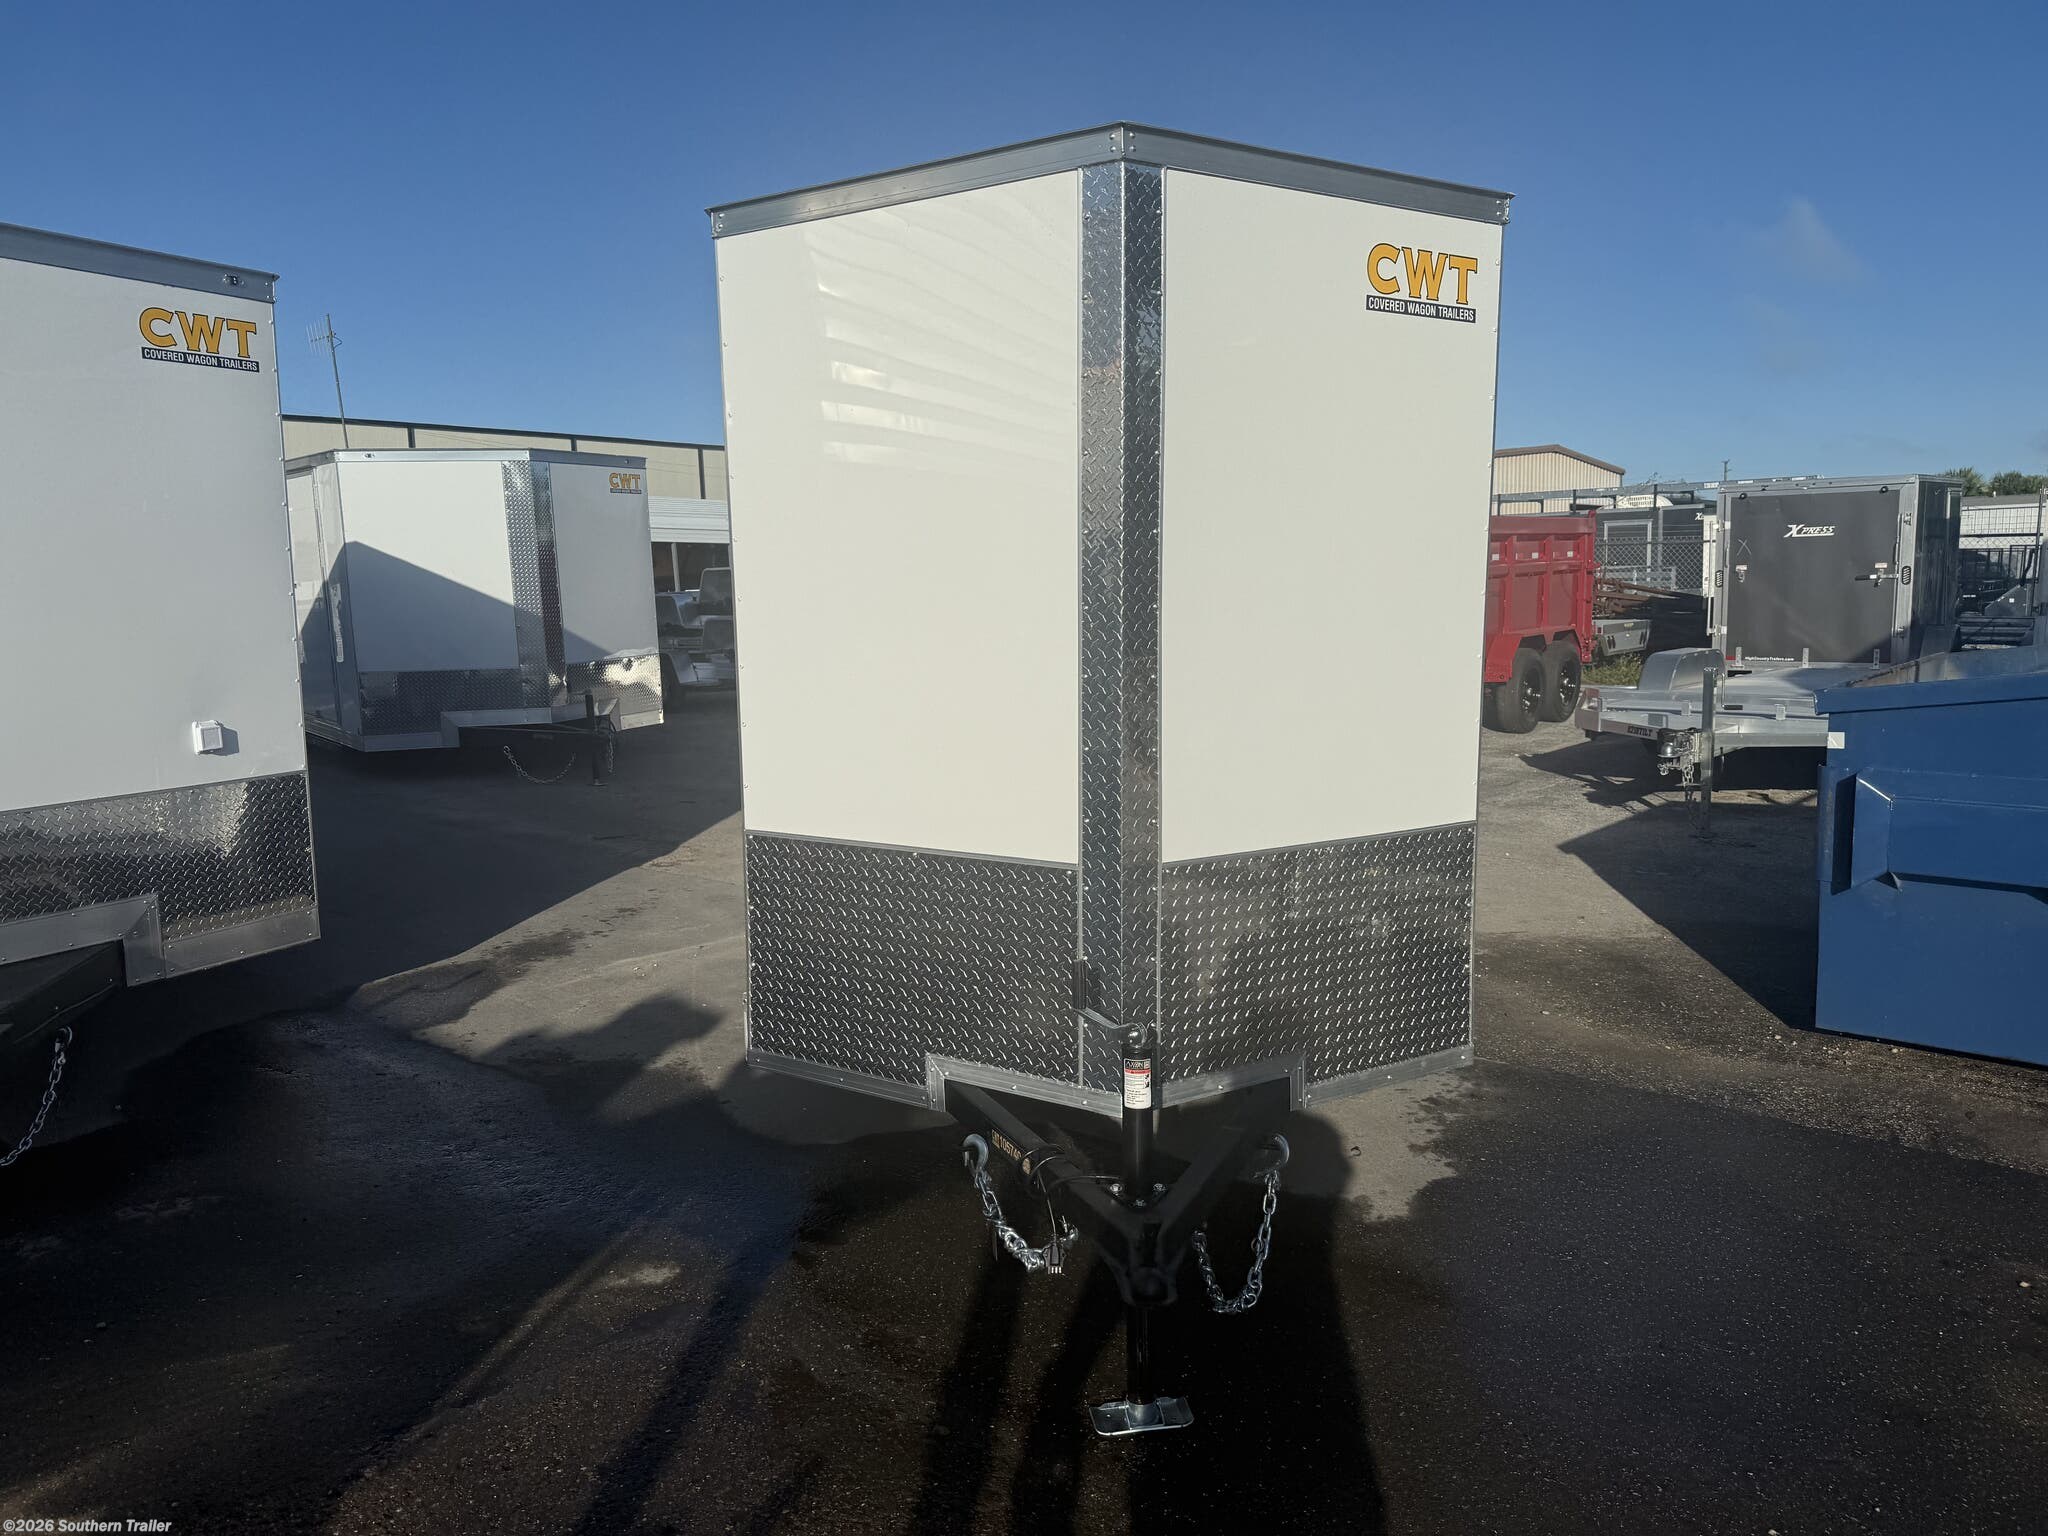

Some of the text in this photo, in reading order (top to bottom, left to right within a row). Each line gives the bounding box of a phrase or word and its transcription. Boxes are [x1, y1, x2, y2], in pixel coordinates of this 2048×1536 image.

[1367, 243, 1478, 305] CWT
[1368, 296, 1474, 321] COVERED WAGON TRAILERS
[139, 307, 258, 358] CWT
[144, 348, 258, 371] COVERED WAGON TRAILERS
[609, 472, 641, 489] CWT
